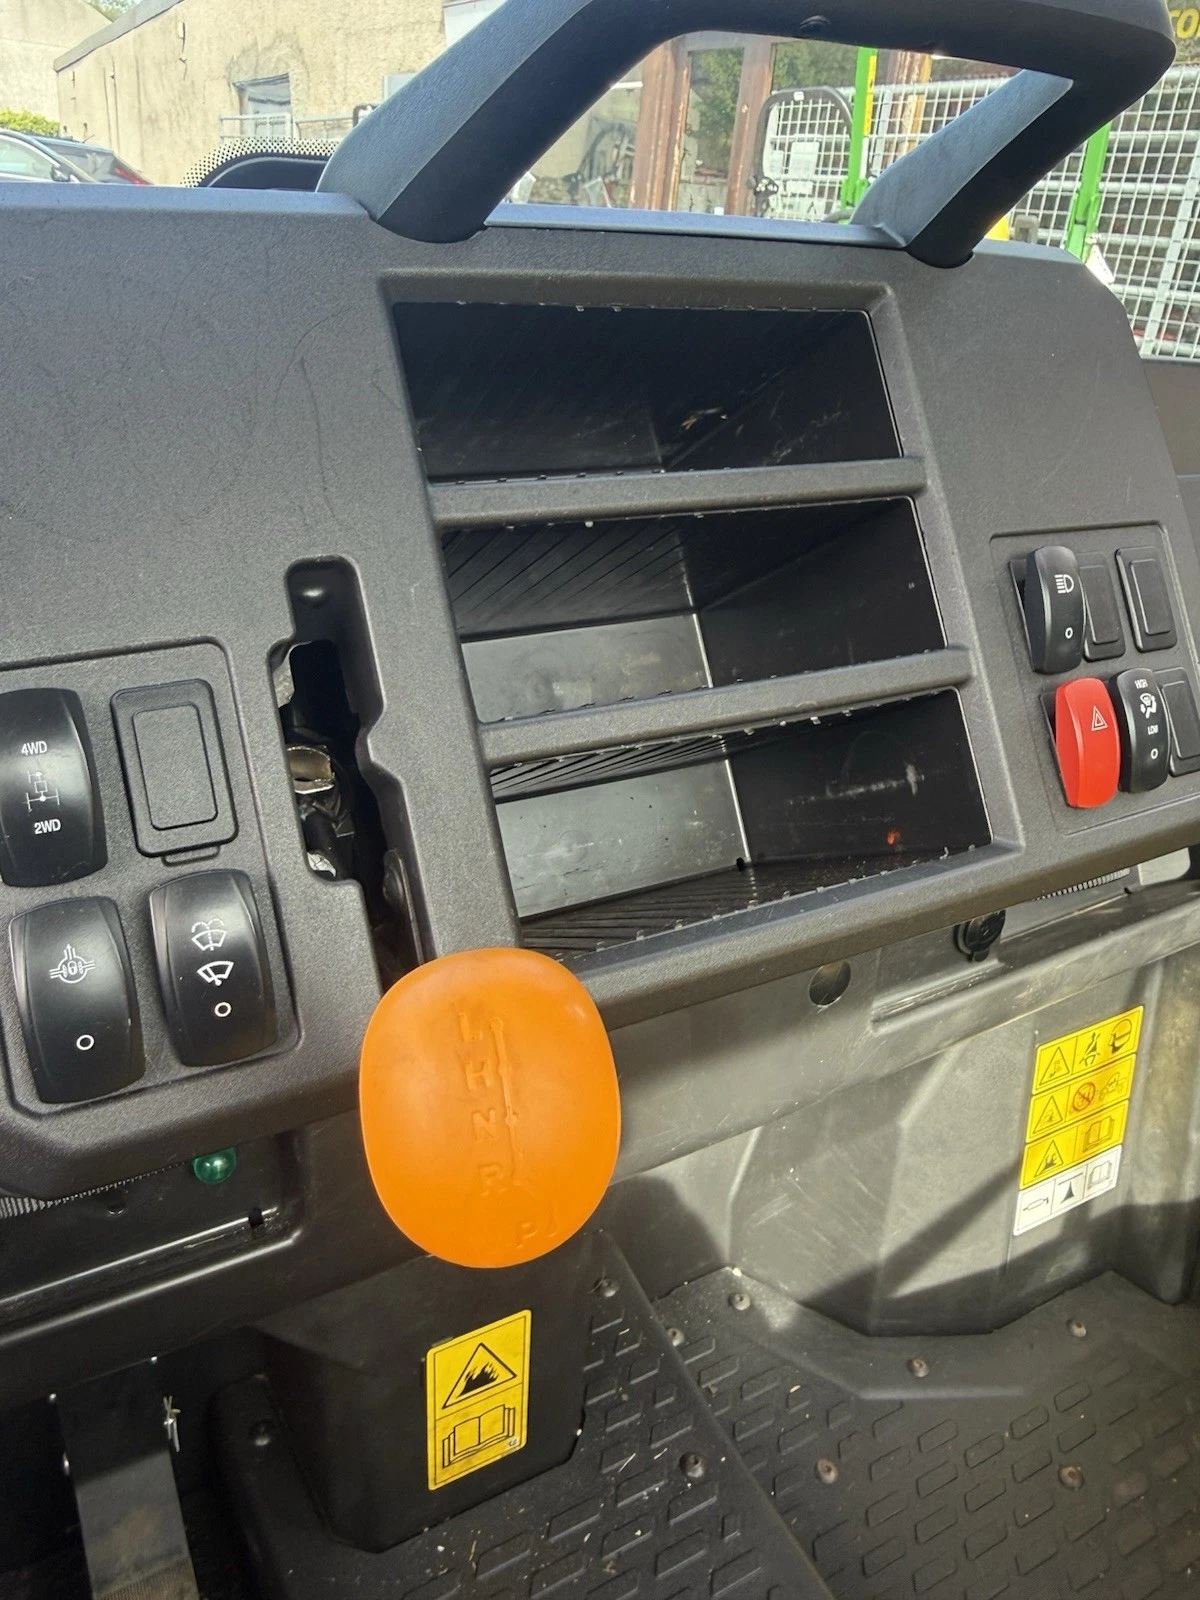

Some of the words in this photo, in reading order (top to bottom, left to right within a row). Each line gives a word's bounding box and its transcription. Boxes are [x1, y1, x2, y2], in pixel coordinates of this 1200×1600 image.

[21, 741, 48, 756] 4WD
[34, 819, 61, 834] 2WD
[465, 1058, 493, 1090] H
[472, 1108, 498, 1142] N
[478, 1163, 508, 1197] R
[516, 1220, 538, 1249] P
